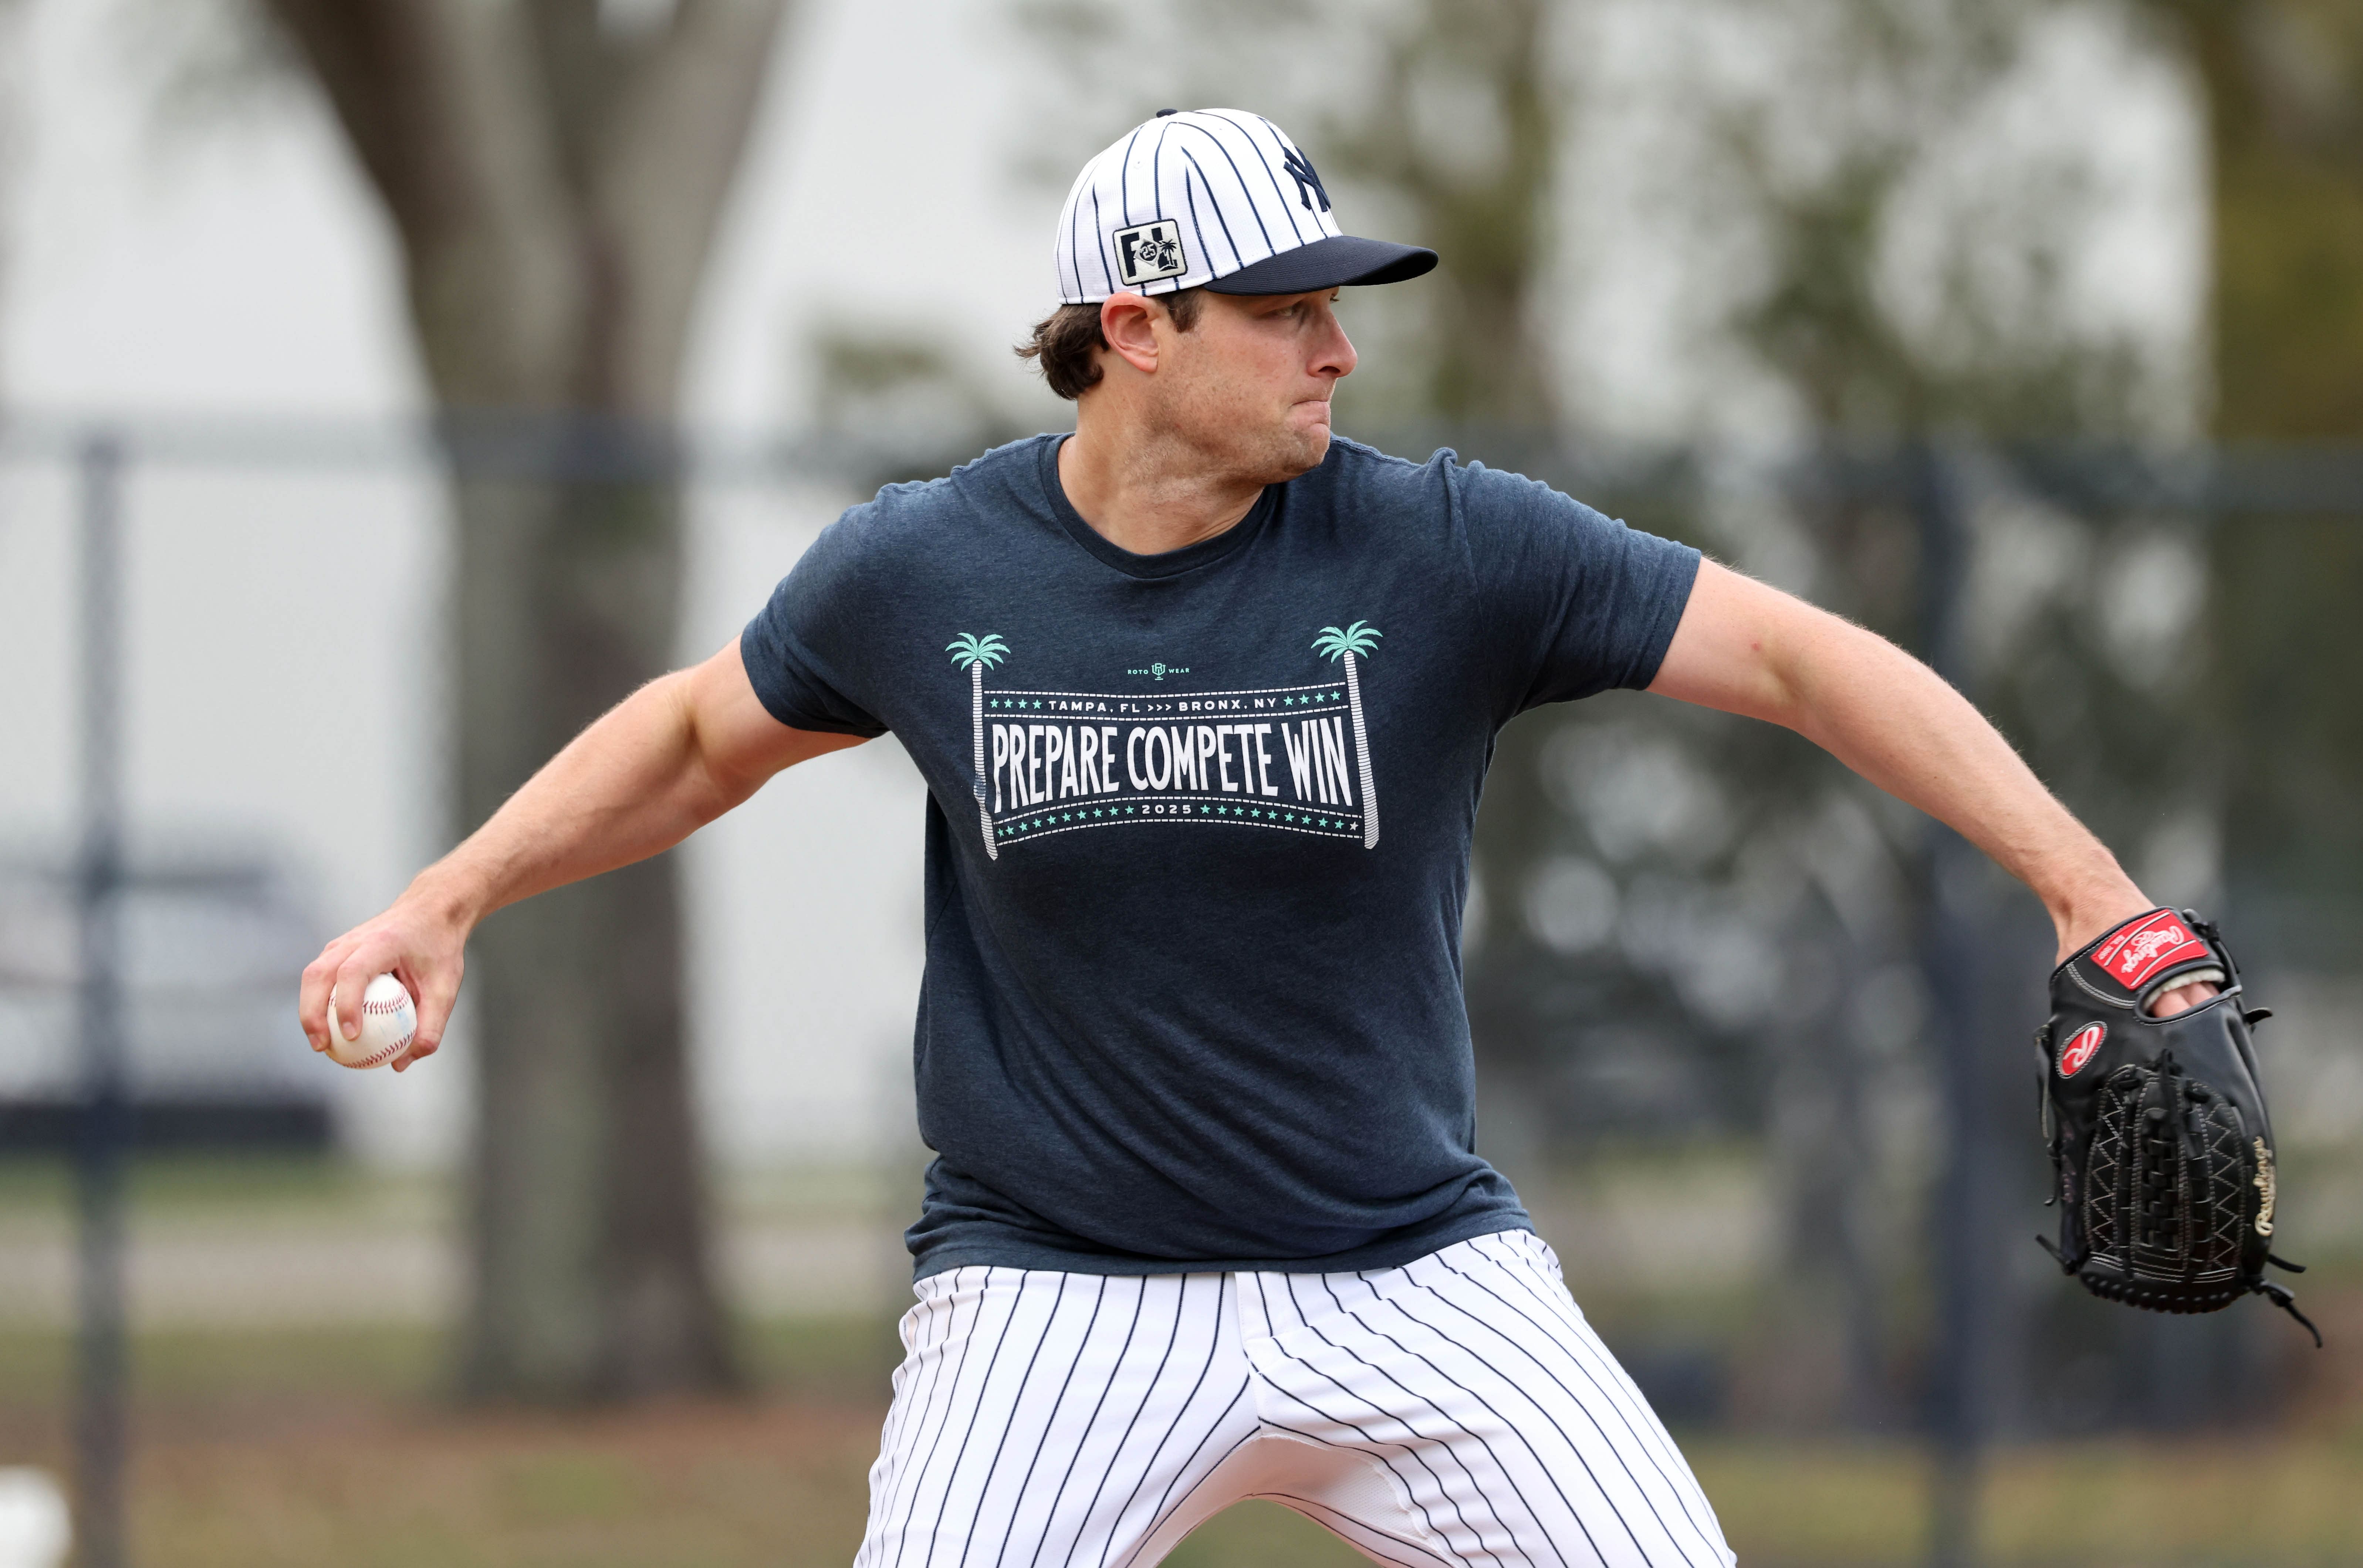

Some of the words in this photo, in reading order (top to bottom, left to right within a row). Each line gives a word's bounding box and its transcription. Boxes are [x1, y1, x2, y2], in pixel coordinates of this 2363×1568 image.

[1048, 701, 1113, 713] TAMPA,
[1120, 704, 1140, 713] FL
[1179, 700, 1247, 711] BRONX,
[1254, 698, 1276, 708] NY
[993, 724, 1119, 813] PREPARE
[1127, 723, 1278, 796] COMPETE
[1281, 716, 1352, 806] WIN
[1142, 805, 1191, 814] 2025
[2121, 925, 2184, 973] Rawlings
[2252, 1136, 2276, 1237] Rawlings
